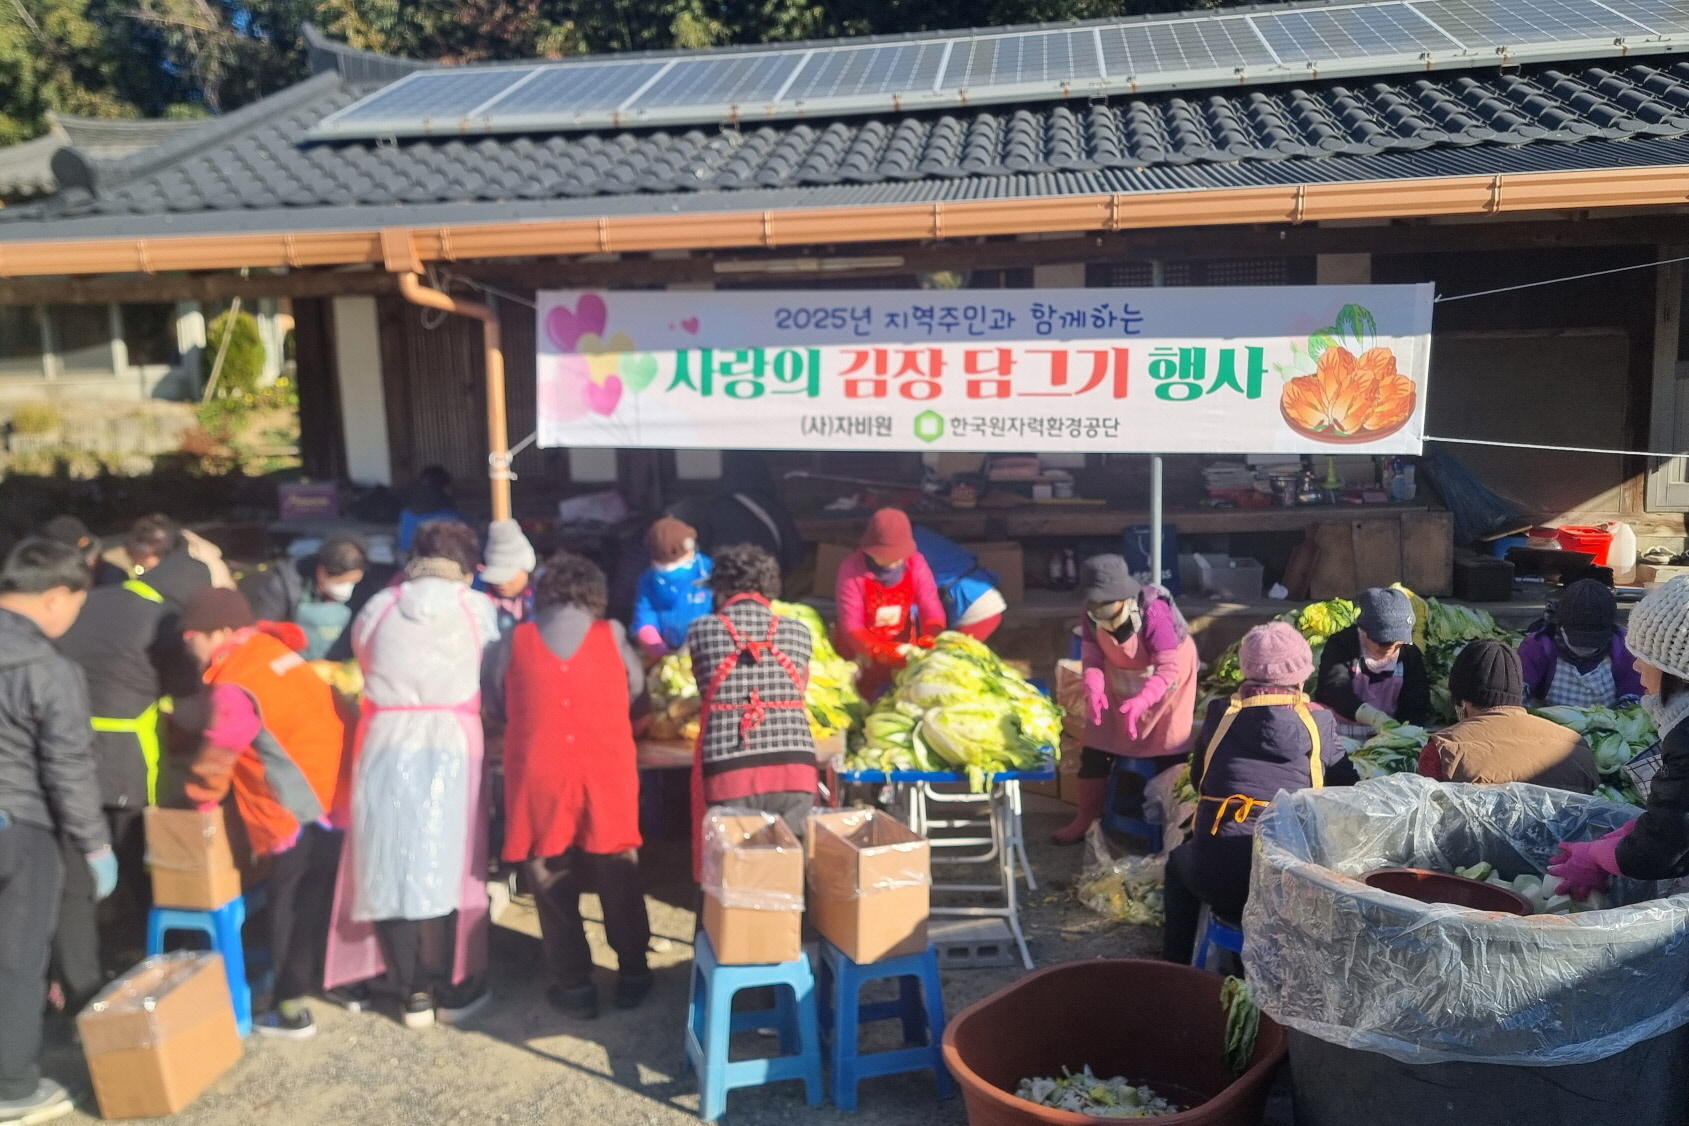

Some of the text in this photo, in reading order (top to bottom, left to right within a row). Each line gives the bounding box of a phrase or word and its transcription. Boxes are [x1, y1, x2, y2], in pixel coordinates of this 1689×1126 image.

[775, 303, 1144, 336] 2025년 지역주민과 함께하는
[666, 345, 1269, 401] 사랑의 김장 담그기 행사
[801, 415, 1120, 438] (사)자비원 한국원자력환경공단
